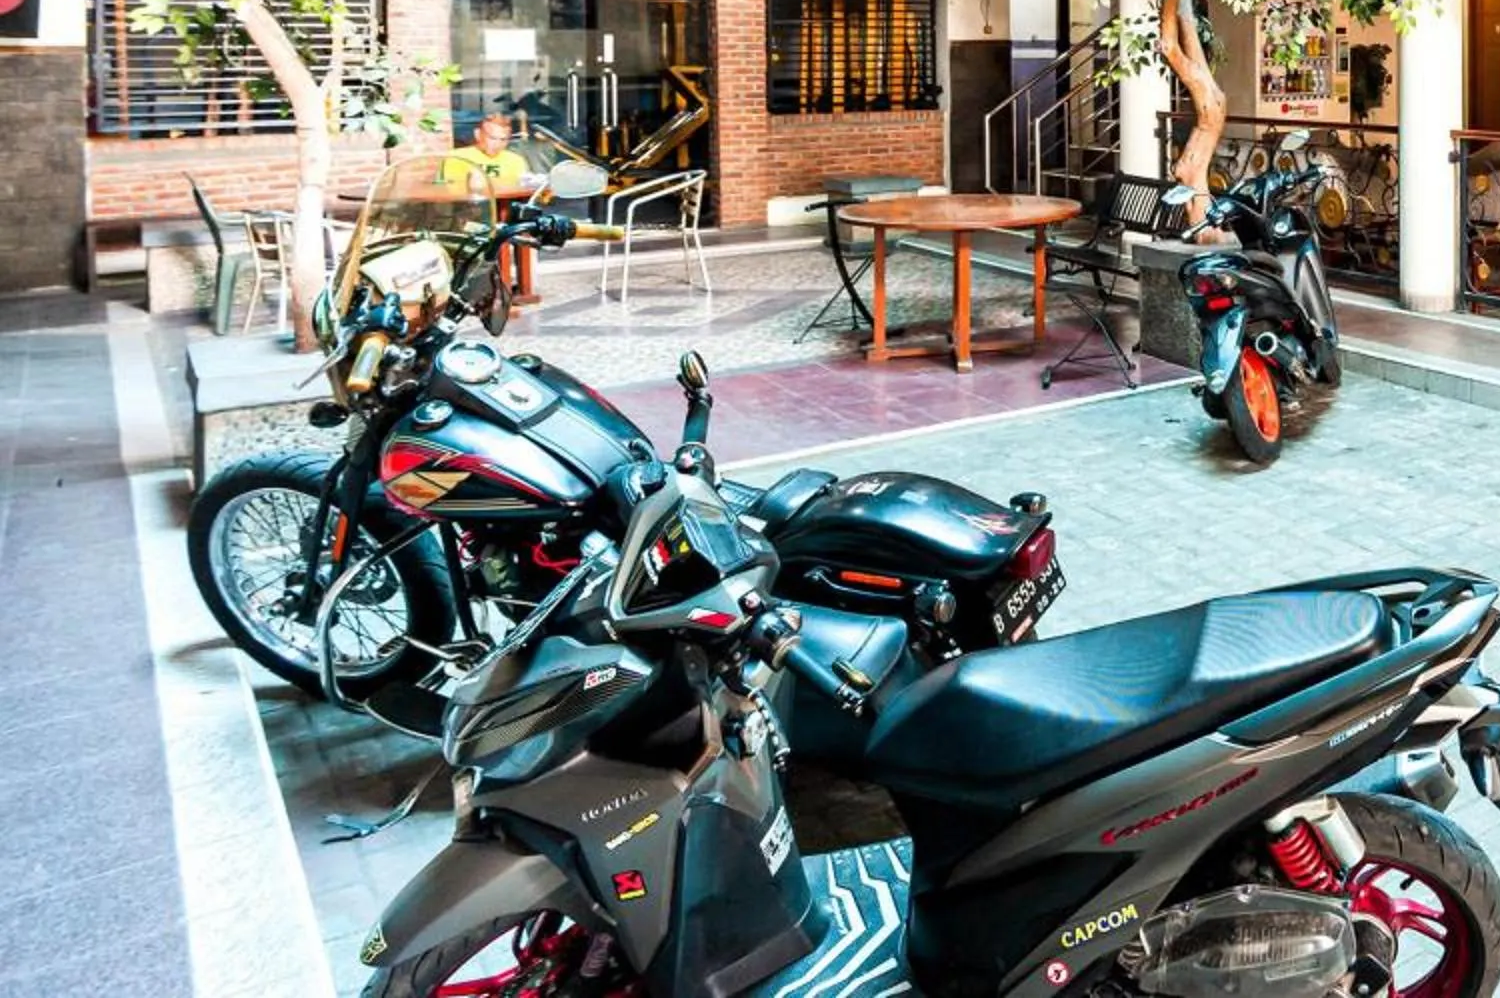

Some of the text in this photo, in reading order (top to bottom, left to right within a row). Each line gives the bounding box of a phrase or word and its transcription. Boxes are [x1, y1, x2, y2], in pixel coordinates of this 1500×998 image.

[993, 613, 1005, 634] B
[1007, 579, 1036, 618] 6555
[1061, 904, 1139, 947] CAPCOM
